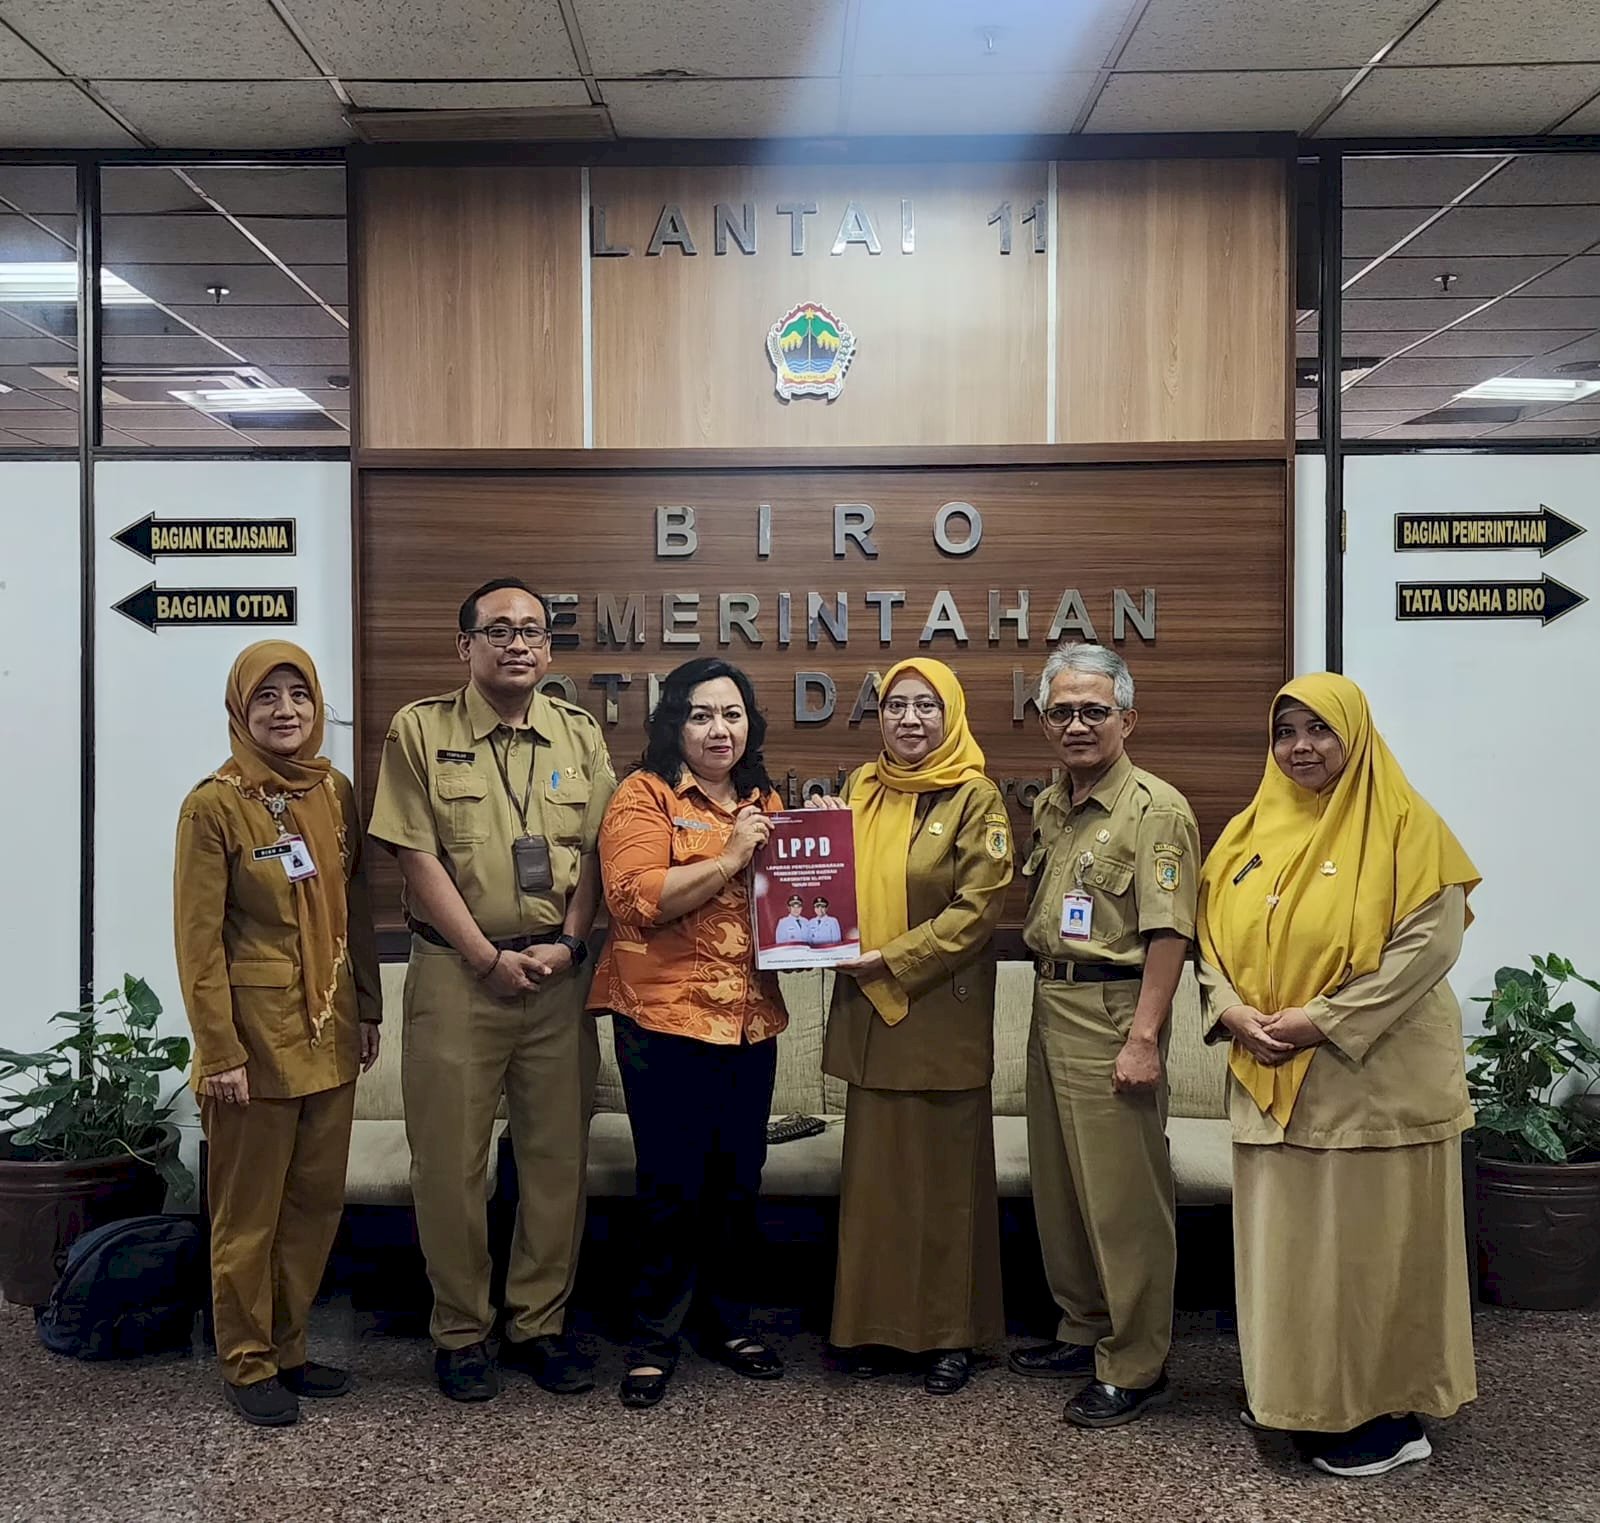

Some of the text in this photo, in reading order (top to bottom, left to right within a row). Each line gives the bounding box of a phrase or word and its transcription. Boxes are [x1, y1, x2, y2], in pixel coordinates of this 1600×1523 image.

[590, 199, 1047, 256] LANTAI 11
[151, 526, 288, 550] BAGIAN KERJASAMA
[656, 501, 984, 559] BIRO
[1403, 520, 1547, 544] BAGIAN PEMERINTAHAN
[156, 595, 288, 619] BAGIAN OTDA
[1402, 587, 1545, 612] TATA USAHA BIRO
[541, 588, 1157, 645] EMERINTAHAN
[777, 836, 831, 858] LPPD
